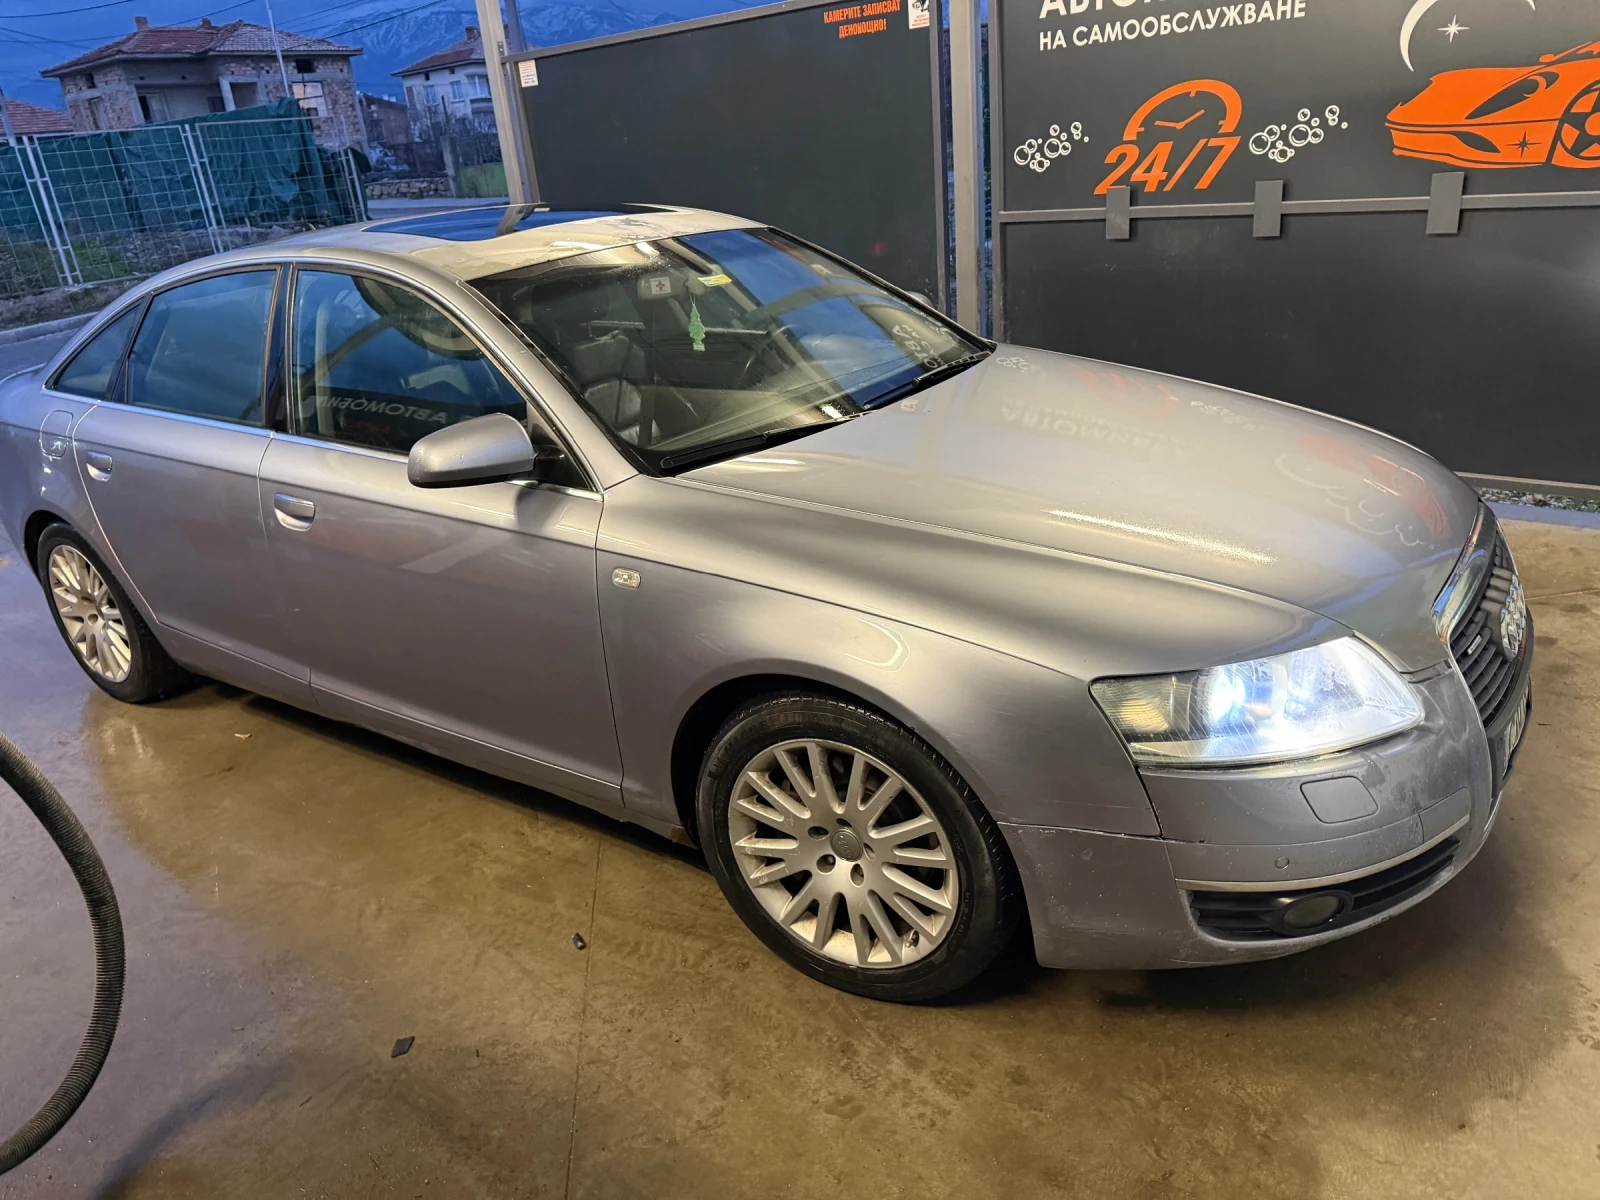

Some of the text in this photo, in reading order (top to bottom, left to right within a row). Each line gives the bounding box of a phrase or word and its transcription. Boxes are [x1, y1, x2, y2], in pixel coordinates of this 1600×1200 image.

[823, 0, 901, 24] КАМЕРИТЕ ЗАПИСВАТ
[839, 18, 887, 39] ДЕНОНОЩНО!
[1039, 0, 1306, 51] НА САМООБСЛУЖВАНЕ
[1093, 136, 1242, 195] 24/7
